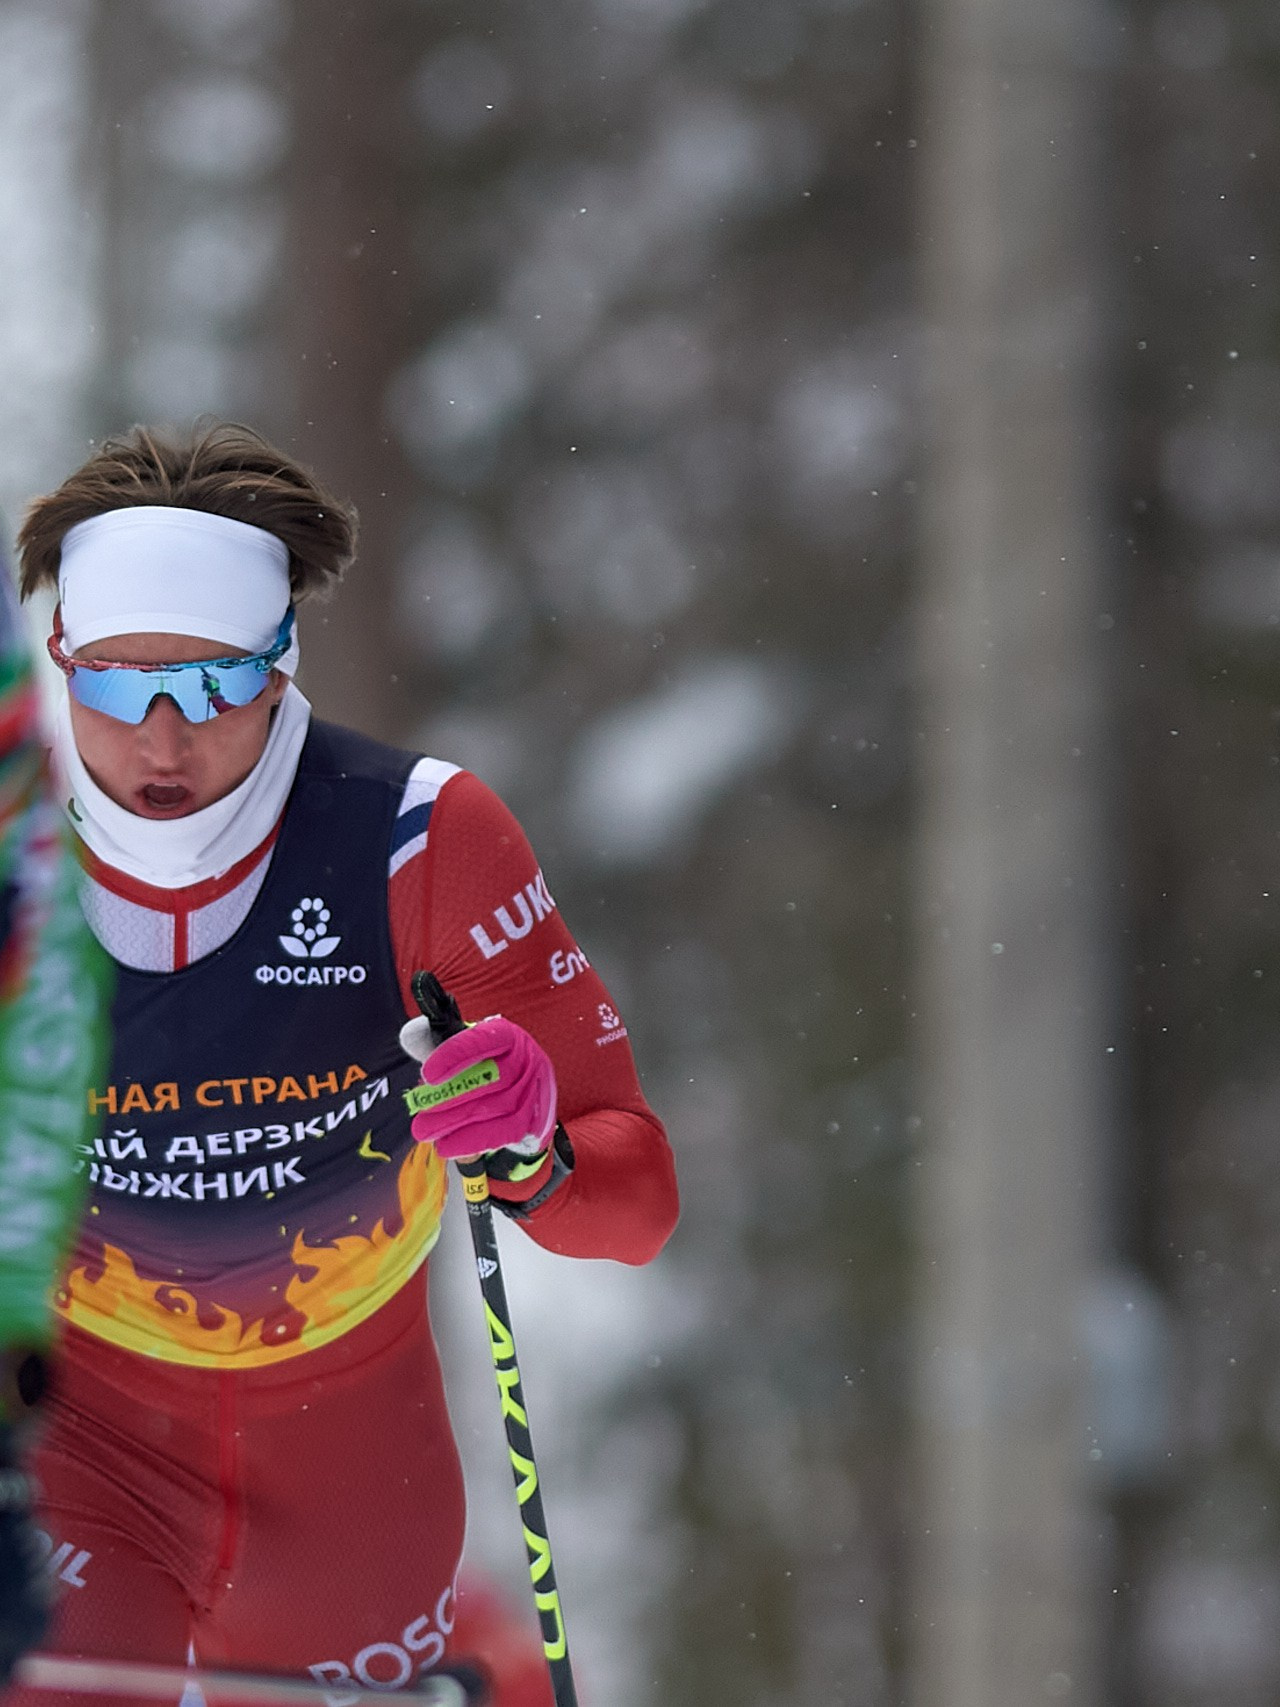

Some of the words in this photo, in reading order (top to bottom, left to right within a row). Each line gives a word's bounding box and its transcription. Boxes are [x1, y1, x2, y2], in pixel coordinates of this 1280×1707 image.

[470, 867, 556, 960] LUK
[255, 964, 367, 985] ФОСАГРО
[195, 1064, 368, 1107] СТРАНА
[165, 1076, 390, 1164] ДЕРЗКИЙ
